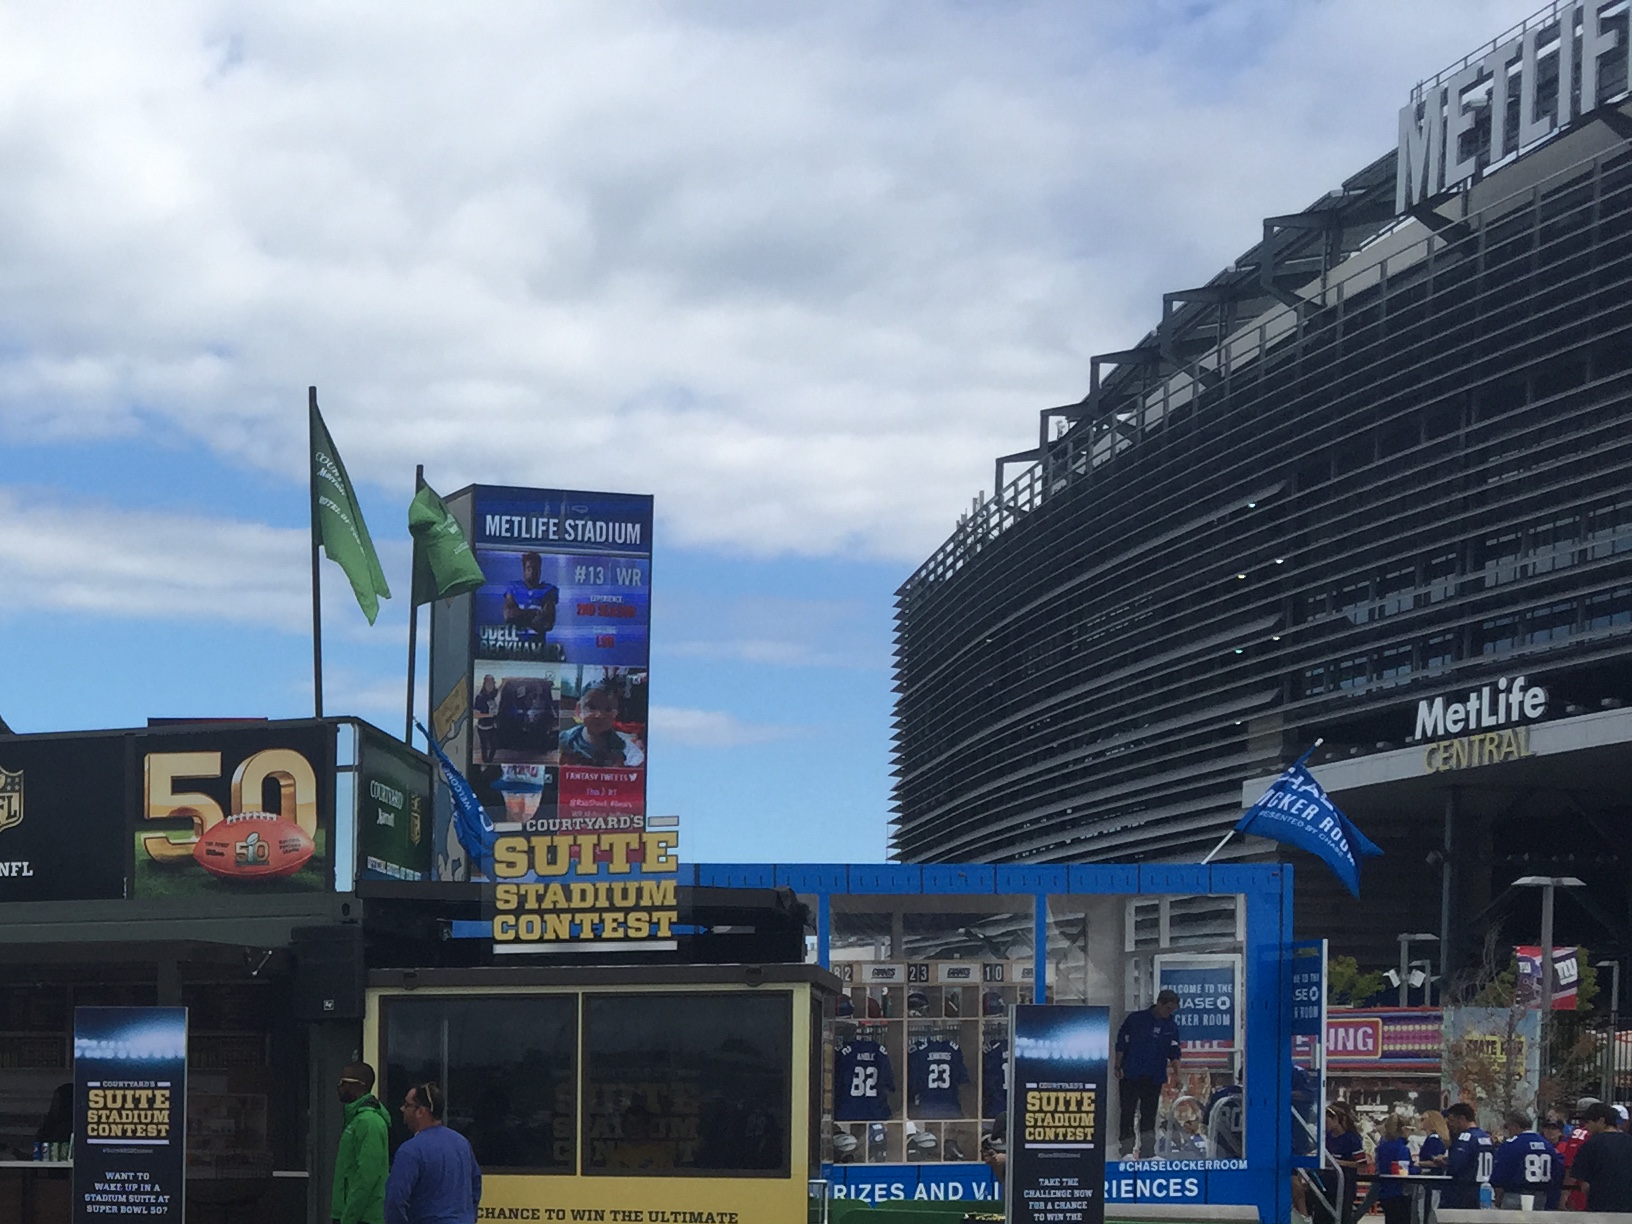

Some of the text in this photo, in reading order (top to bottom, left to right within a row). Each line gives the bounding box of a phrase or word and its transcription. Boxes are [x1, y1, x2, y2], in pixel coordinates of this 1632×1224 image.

[1395, 0, 1632, 216] METLIF
[486, 514, 559, 540] METLIFE
[565, 519, 641, 544] STADIUM
[575, 566, 642, 587] #13 WR
[1414, 676, 1548, 741] MetLife
[1423, 726, 1535, 775] CENTRAL
[141, 749, 317, 861] 50
[526, 815, 645, 832] COURTYARD'S
[493, 831, 679, 878] SUITE
[495, 878, 678, 911] STADIUM
[493, 910, 678, 941] CONTEST
[985, 963, 1003, 981] 10
[1179, 997, 1215, 1010] HASE
[1174, 1014, 1199, 1027] CKER
[1326, 1026, 1374, 1052] ING
[850, 1066, 879, 1098] 82
[928, 1063, 951, 1089] 23
[88, 1089, 171, 1109] SUITE
[1026, 1091, 1096, 1112] SUITE
[87, 1109, 170, 1123] STADIUM
[1025, 1112, 1095, 1126] STADIUM
[87, 1123, 170, 1137] CONTEST
[1025, 1127, 1095, 1141] CONTEST
[105, 1171, 150, 1181] WANT TO
[1119, 1159, 1249, 1173] #CHASELOCKERROOM
[1525, 1153, 1552, 1183] 80
[94, 1182, 161, 1192] WAKE UP IN A
[834, 1178, 1200, 1202] RIZES AND RIENCES
[84, 1193, 171, 1204] STADIUM SUITE AT
[86, 1204, 168, 1215] SUPER BOWL 50?
[476, 1207, 739, 1224] CHANCE TO WIN THE ULTIMATE
